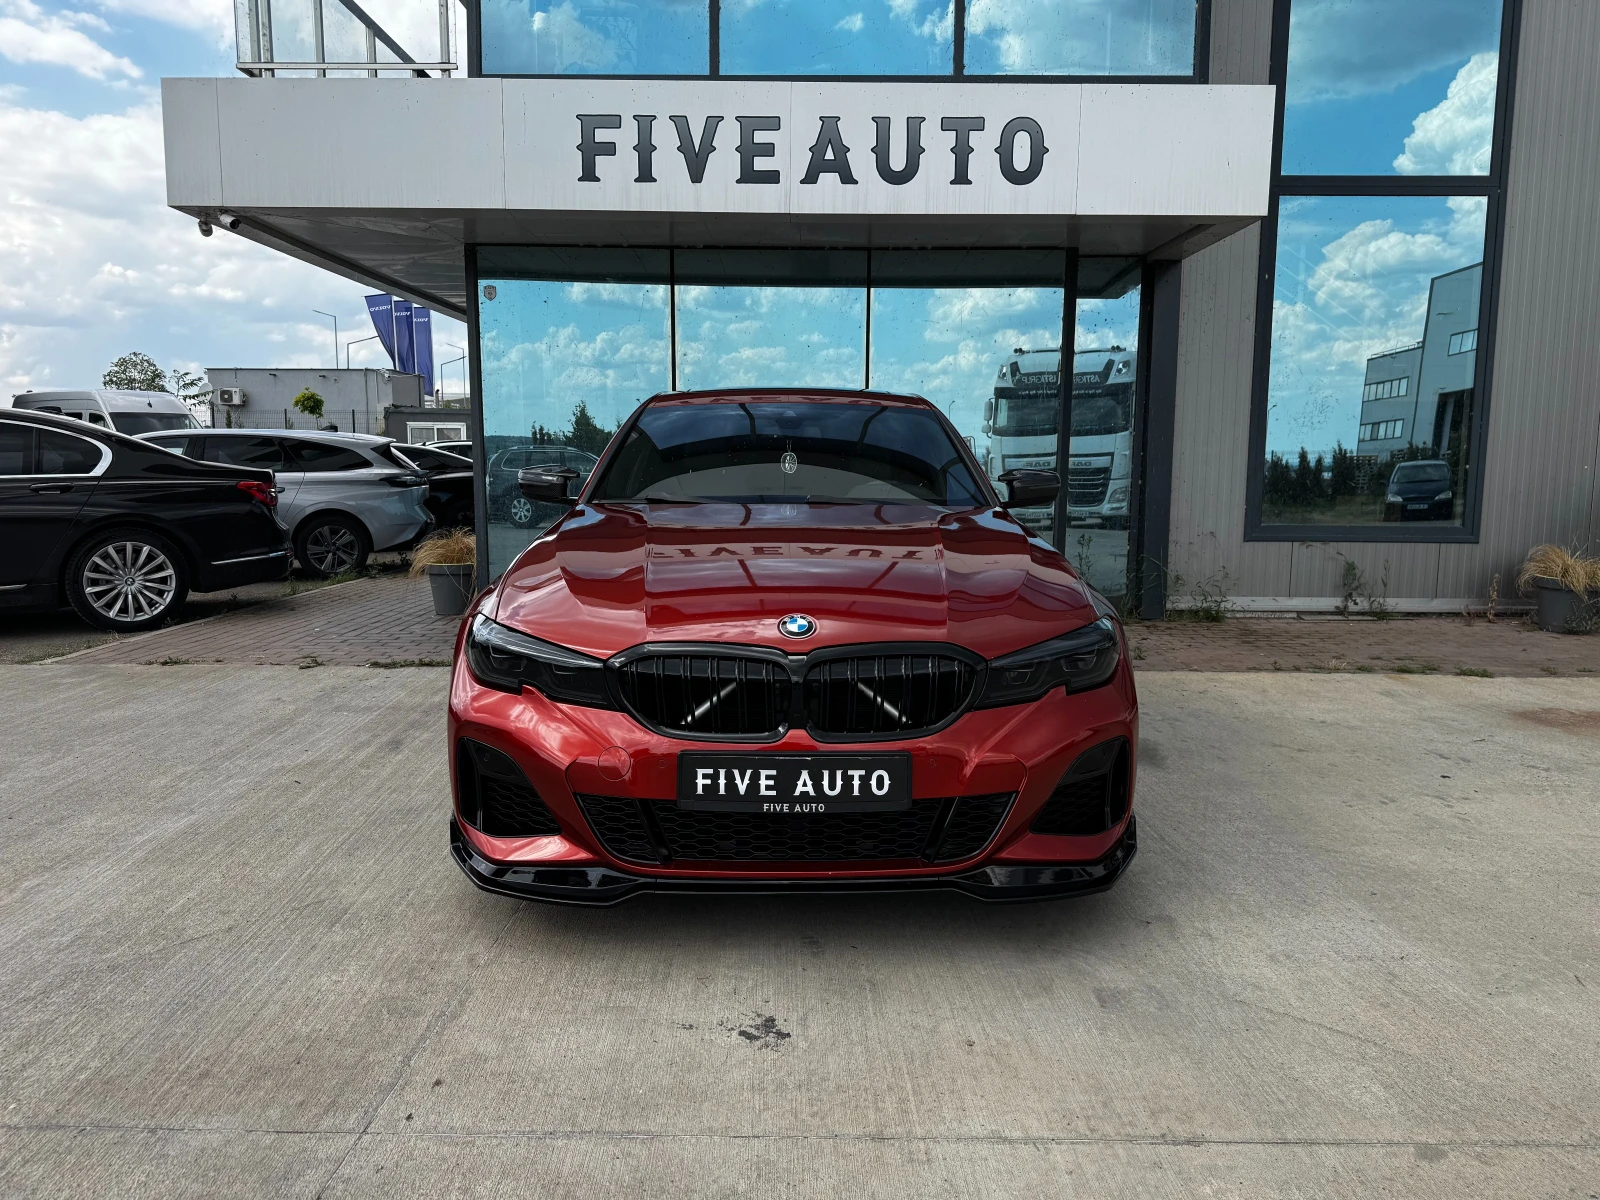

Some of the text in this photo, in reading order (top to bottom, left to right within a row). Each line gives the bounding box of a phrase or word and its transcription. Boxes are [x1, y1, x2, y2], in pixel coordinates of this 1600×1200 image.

[695, 768, 891, 796] FIVE AUTO
[763, 803, 825, 813] FIVE AUTO
